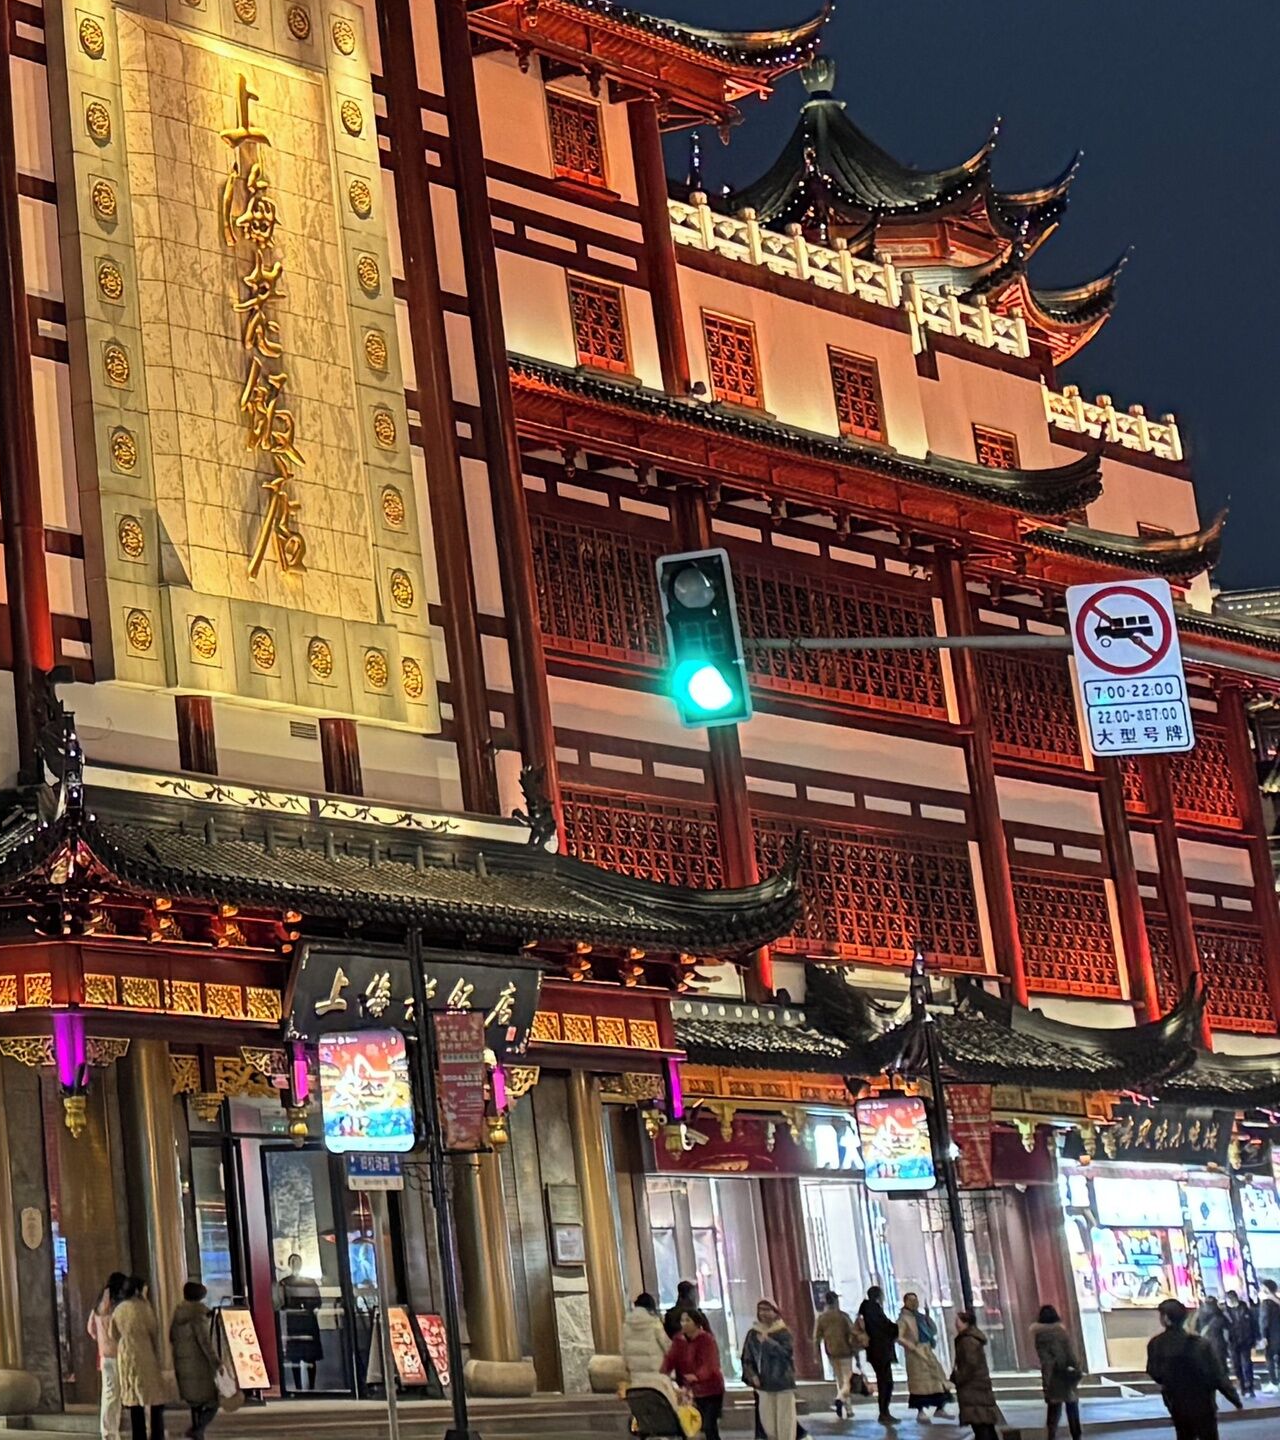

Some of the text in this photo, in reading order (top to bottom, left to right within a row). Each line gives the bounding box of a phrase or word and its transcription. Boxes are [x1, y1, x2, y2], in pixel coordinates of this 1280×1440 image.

[1093, 682, 1173, 699] 7:00-22:00
[1097, 725, 1183, 745] 大型号牌
